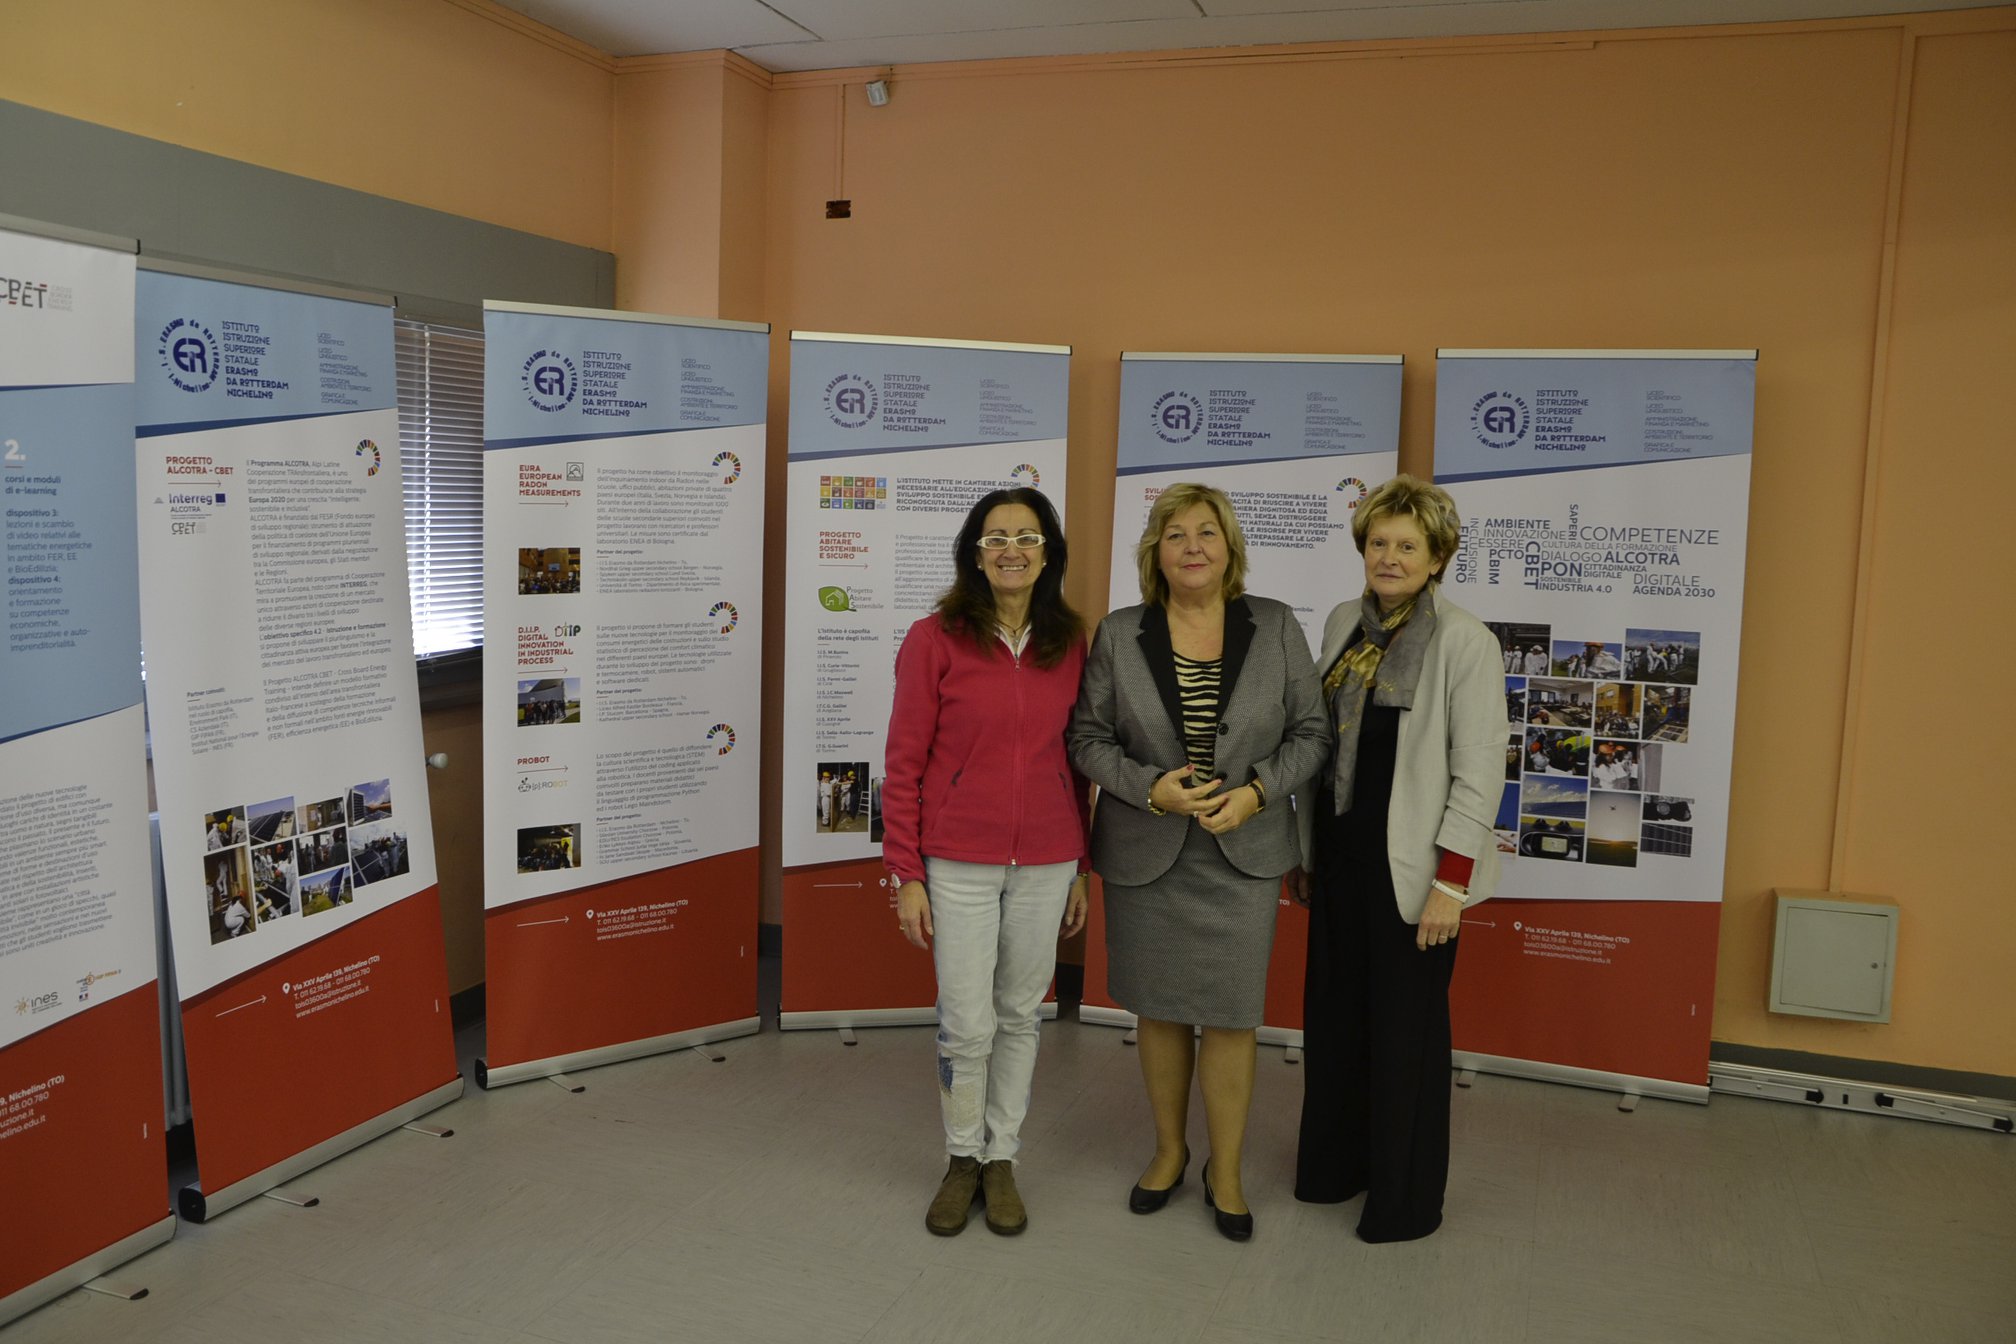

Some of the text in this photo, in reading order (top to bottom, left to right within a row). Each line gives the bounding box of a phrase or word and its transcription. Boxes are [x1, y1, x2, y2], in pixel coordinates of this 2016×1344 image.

[222, 321, 260, 334] ISTITUTO
[223, 332, 271, 345] ISTRUZIONE
[224, 343, 266, 356] SUPERIORE
[224, 354, 259, 366] STATALE
[583, 351, 622, 361] ISTITUTO
[583, 360, 632, 371] ISTRUZIONE
[225, 366, 258, 377] ERASMO
[583, 369, 627, 380] SUPERIORE
[884, 374, 921, 382] ISTITUTO
[226, 376, 289, 390] DA ROTTERDAM
[582, 379, 619, 389] STATALE
[884, 382, 931, 391] ISTRUZIONE
[227, 388, 273, 400] NICHELINO
[582, 388, 617, 398] ERASMO
[883, 390, 926, 399] SUPERIORE
[582, 398, 647, 409] DA ROTTERDAM
[883, 399, 918, 407] STATALE
[1209, 398, 1256, 406] ISTRUZIONE
[1536, 398, 1589, 406] ISTRUZIONE
[582, 408, 631, 417] NICHELINO
[883, 407, 916, 415] ERASMO
[1209, 406, 1250, 414] SUPERIORE
[1536, 407, 1583, 415] SUPERIORE
[896, 416, 946, 425] ROTTERDAM
[1208, 414, 1243, 422] STATALE
[1536, 416, 1575, 424] STATALE
[882, 424, 929, 432] NICHELINO
[1535, 425, 1573, 433] ERASMO
[1221, 431, 1271, 439] ROTTERDAM
[1535, 434, 1606, 442] DA ROTTERDAM
[1207, 439, 1253, 447] NICHELINO
[1535, 443, 1586, 451] NICHELINO
[4, 439, 27, 461] 2.
[166, 456, 213, 466] PROGETTO
[167, 466, 234, 476] ALCOTRA CBET
[519, 464, 541, 472] EURA
[5, 475, 25, 484] corsi
[33, 475, 61, 485] moduli
[519, 473, 562, 481] EUROPEAN
[5, 486, 58, 497] di e-learning
[519, 489, 581, 497] MEASUREMENTS
[1231, 491, 1265, 499] SVILUPPO
[1266, 492, 1310, 500] SOSTENIBILE
[932, 493, 976, 501] SOSTENIBILE
[896, 499, 946, 507] RICONOSCIUTA
[1262, 499, 1294, 507] RIUSCIRE
[1302, 500, 1328, 508] VIVERE
[6, 508, 51, 518] dispositivo
[170, 505, 201, 513] ALCOTRA
[1260, 507, 1296, 515] DIGNITOSA
[1309, 508, 1328, 516] EQUA
[1279, 514, 1328, 522] DISTRUGGERE
[1568, 503, 1579, 541] SAPERI
[1308, 522, 1345, 531] POSSIAMO
[1485, 518, 1551, 530] AMBIENTE
[819, 531, 861, 539] PROGETTO
[1303, 530, 1329, 538] VIVERE
[1483, 529, 1567, 541] INNOVAZIONE
[1579, 526, 1720, 545] COMPETENZE
[819, 538, 852, 546] ABITARE
[1260, 541, 1316, 549] RINNOVAMENTO.
[1478, 538, 1525, 549] ESSERE
[1541, 541, 1678, 552] CULTURA DELLA FORMAZIONE
[1455, 526, 1469, 584] FUTURO
[1467, 517, 1479, 584] INCLUSIONE
[1489, 549, 1525, 560] PCTO
[1541, 550, 1603, 563] DIALOGO
[1604, 551, 1681, 566] ALCOTRA
[1524, 541, 1541, 591] CBET
[1540, 561, 1582, 578] PON
[1583, 563, 1647, 573] CITTADINANZA
[1488, 559, 1500, 585] BIM
[1583, 571, 1622, 580] DIGITALE
[8, 576, 52, 586] dispositivo
[1540, 576, 1582, 584] SOSTENIBILE
[1633, 573, 1701, 588] DIGITALE
[846, 586, 874, 594] Progetto
[1539, 582, 1613, 595] INDUSTRIA 4.0
[1632, 586, 1716, 599] AGENDA 2030
[850, 594, 872, 602] Abitare
[851, 602, 884, 610] Sostenibile
[518, 626, 540, 634] D.I.I.P.
[518, 634, 548, 642] DIGITAL
[518, 641, 564, 649] INNOVATION
[527, 648, 574, 657] INDUSTRIAL
[517, 657, 554, 665] PROCESS
[517, 755, 551, 765] PROBOT
[1550, 929, 1569, 938] Aprile
[1583, 932, 1615, 943] Nichelino
[1615, 935, 1631, 945] (TO)
[9, 1074, 65, 1102] Nichelino (TO)
